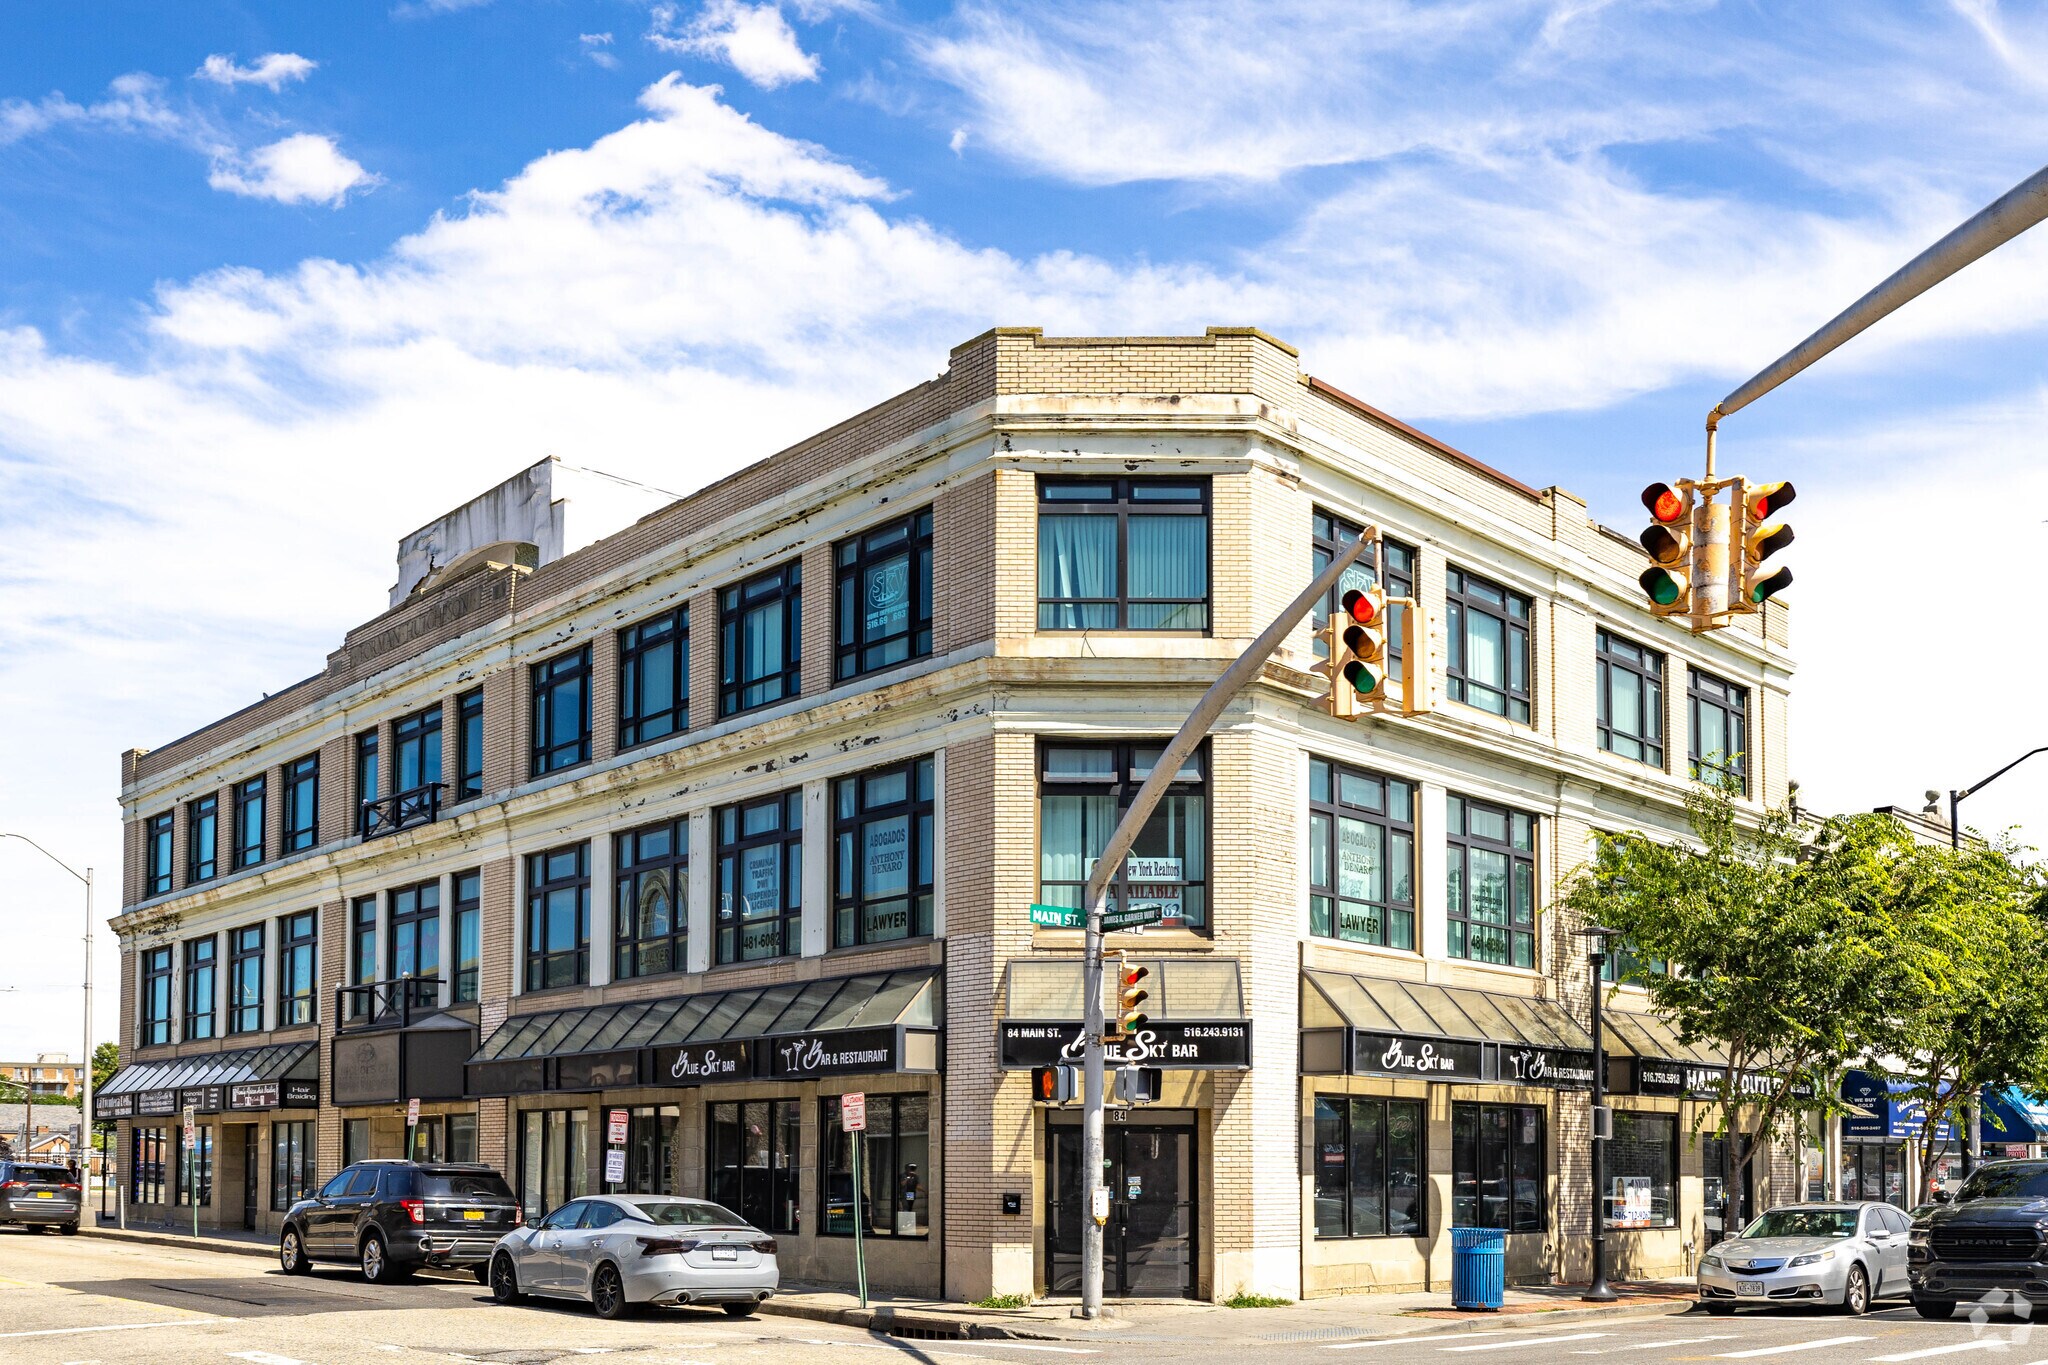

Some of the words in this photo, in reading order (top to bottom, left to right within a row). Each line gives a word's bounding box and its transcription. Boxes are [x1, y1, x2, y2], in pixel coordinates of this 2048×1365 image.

[869, 828, 906, 848] ABOGADOS
[1341, 829, 1377, 850] ABOGADOS
[749, 857, 776, 870] CRIMINAL
[869, 850, 905, 866] ANTHONY
[1341, 851, 1376, 866] ANTHONY
[752, 867, 774, 880] TRAFFIC
[871, 860, 903, 875] DENARO
[1138, 861, 1153, 877] York
[1154, 861, 1180, 877] Realtors
[1344, 861, 1373, 876] DENARO
[756, 879, 769, 889] DWI
[747, 888, 779, 902] SUSPENDED
[1109, 885, 1180, 899] AAILABLE
[751, 899, 774, 911] LICENSE
[867, 911, 907, 931] LAWYER
[1032, 910, 1062, 925] MAIN
[1064, 913, 1082, 926] ST.
[1124, 911, 1144, 921] GARNER
[1340, 913, 1379, 934] LAWYER
[1007, 1028, 1019, 1038] 84
[1021, 1028, 1045, 1038] MAIN
[1047, 1028, 1062, 1038] ST.
[1184, 1027, 1244, 1037] 516.243.9131
[1126, 1030, 1168, 1061] SKY
[1172, 1044, 1198, 1058] BAR
[803, 1038, 832, 1070] BAR
[832, 1053, 838, 1065] &
[839, 1049, 888, 1065] RESTAURANT
[1381, 1038, 1415, 1069] BLUE
[1416, 1043, 1440, 1071] SKY
[1440, 1058, 1455, 1071] BAR
[671, 1049, 699, 1078] BLUE
[700, 1049, 722, 1076] SKY
[722, 1060, 736, 1073] BAR
[1529, 1052, 1552, 1079] BAR
[1552, 1068, 1558, 1078] &
[1558, 1067, 1595, 1081] RESTAURANT
[287, 1093, 317, 1101] Braiding
[1114, 1110, 1126, 1121] 84
